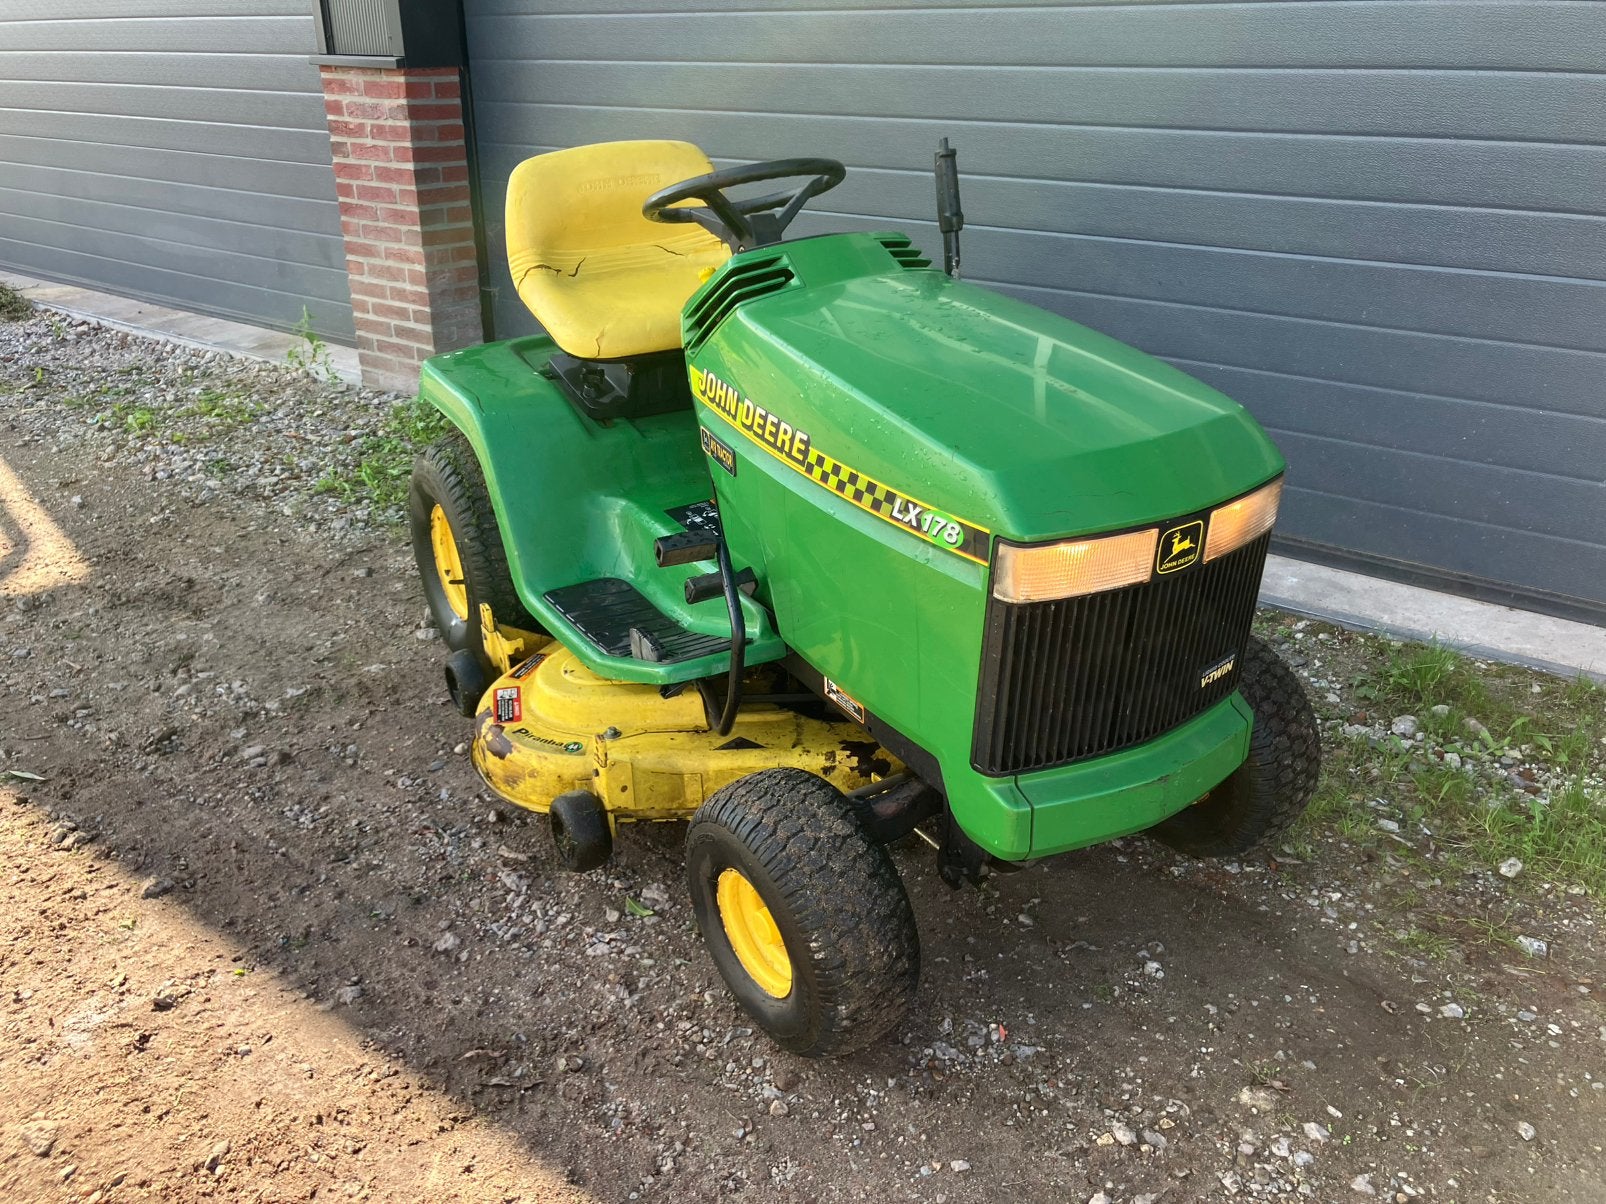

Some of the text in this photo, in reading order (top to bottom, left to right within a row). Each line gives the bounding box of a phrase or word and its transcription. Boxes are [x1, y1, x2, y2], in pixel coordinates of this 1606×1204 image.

[698, 368, 809, 464] JOHN DEERE
[891, 498, 961, 545] LX 178
[1160, 553, 1196, 570] JOHN DEERE
[1201, 659, 1234, 688] V-TWIN
[512, 727, 565, 747] Piranha
